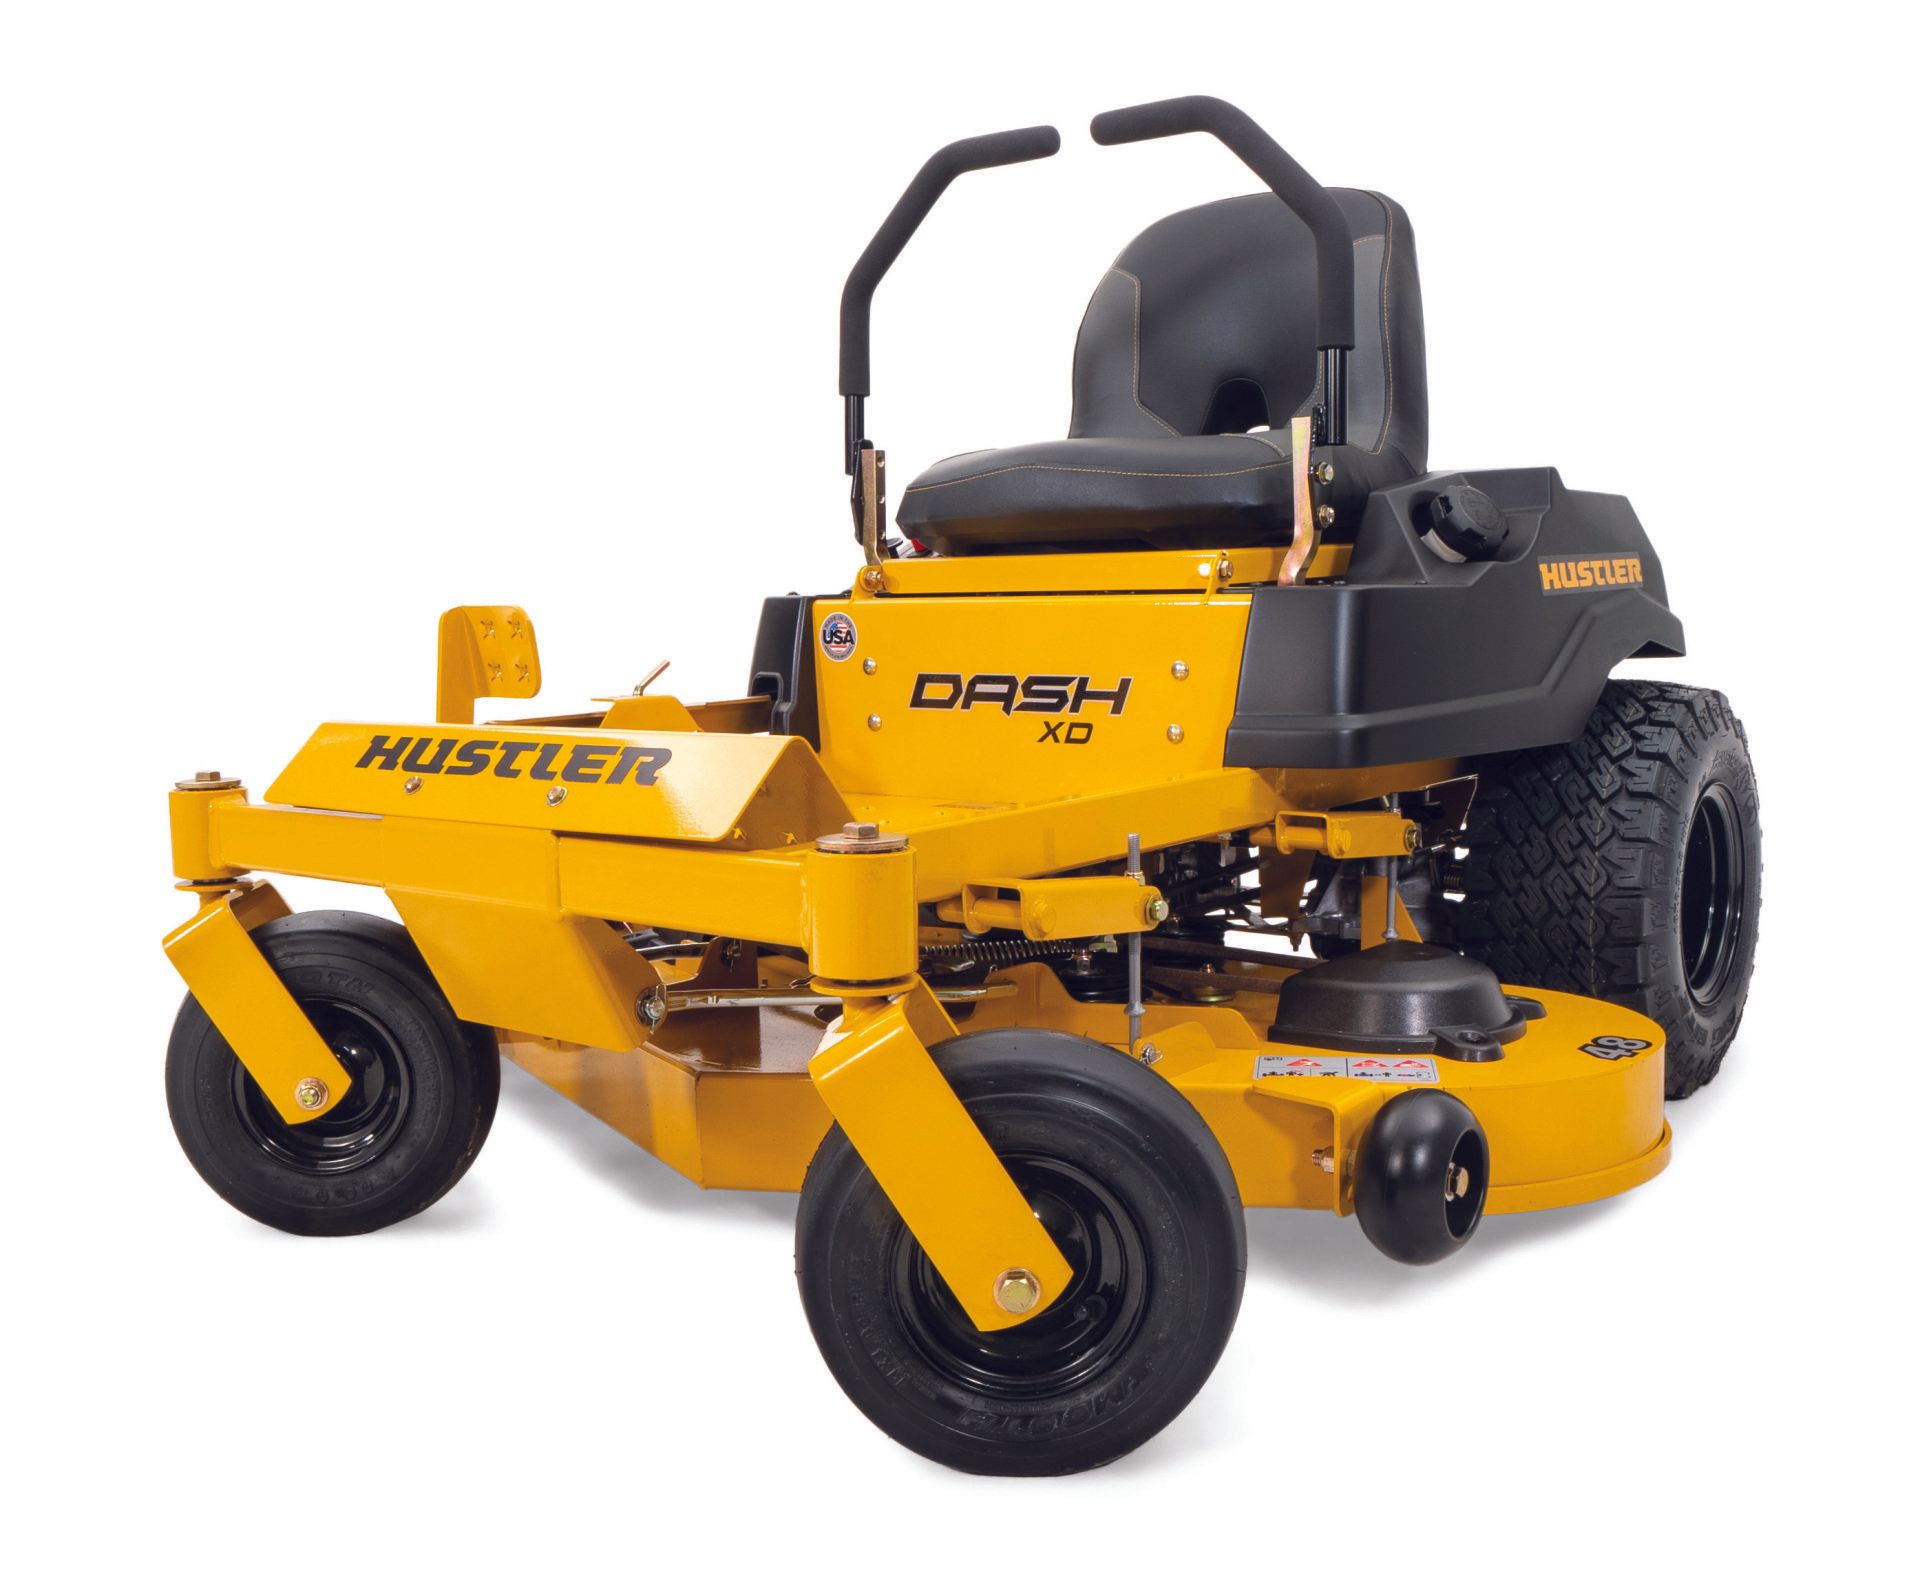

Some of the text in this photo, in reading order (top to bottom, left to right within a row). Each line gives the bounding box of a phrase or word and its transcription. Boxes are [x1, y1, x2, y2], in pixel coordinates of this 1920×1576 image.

[1538, 559, 1643, 591] HUSTLER
[823, 629, 855, 645] USA
[908, 672, 1134, 719] DASH
[1036, 720, 1094, 744] XD
[355, 735, 672, 786] HUSTLER
[1577, 1035, 1653, 1061] 48
